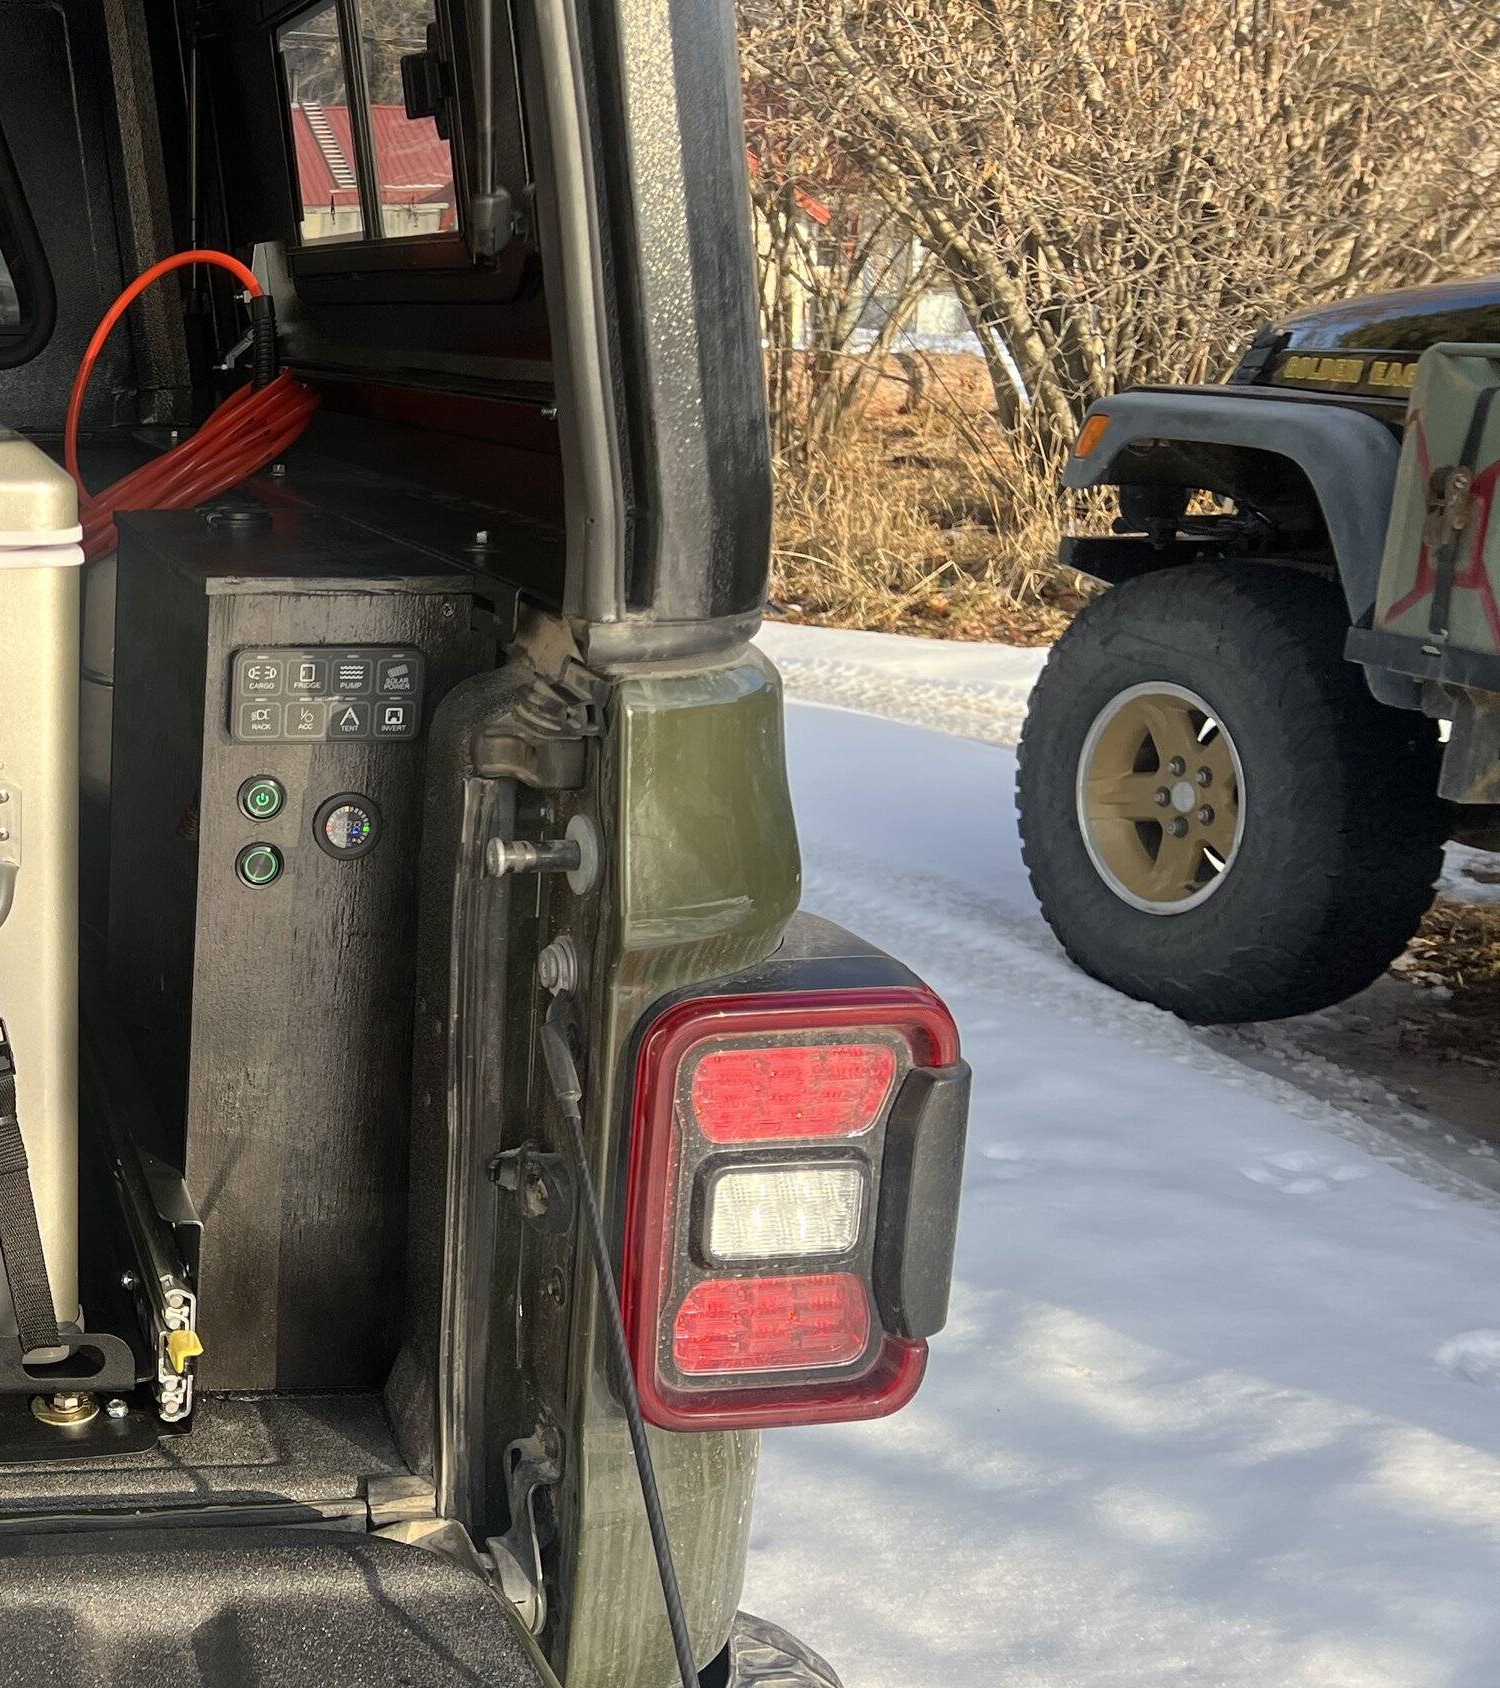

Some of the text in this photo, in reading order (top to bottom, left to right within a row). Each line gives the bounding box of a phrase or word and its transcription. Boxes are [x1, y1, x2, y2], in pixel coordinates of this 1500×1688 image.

[1284, 356, 1364, 384] GOLDEN
[249, 682, 275, 690] CARGO
[293, 681, 321, 689] FRIDGE
[340, 681, 362, 690] PUMP
[251, 723, 272, 731] RACK
[341, 724, 358, 732] TENT
[381, 724, 407, 732] INVERT
